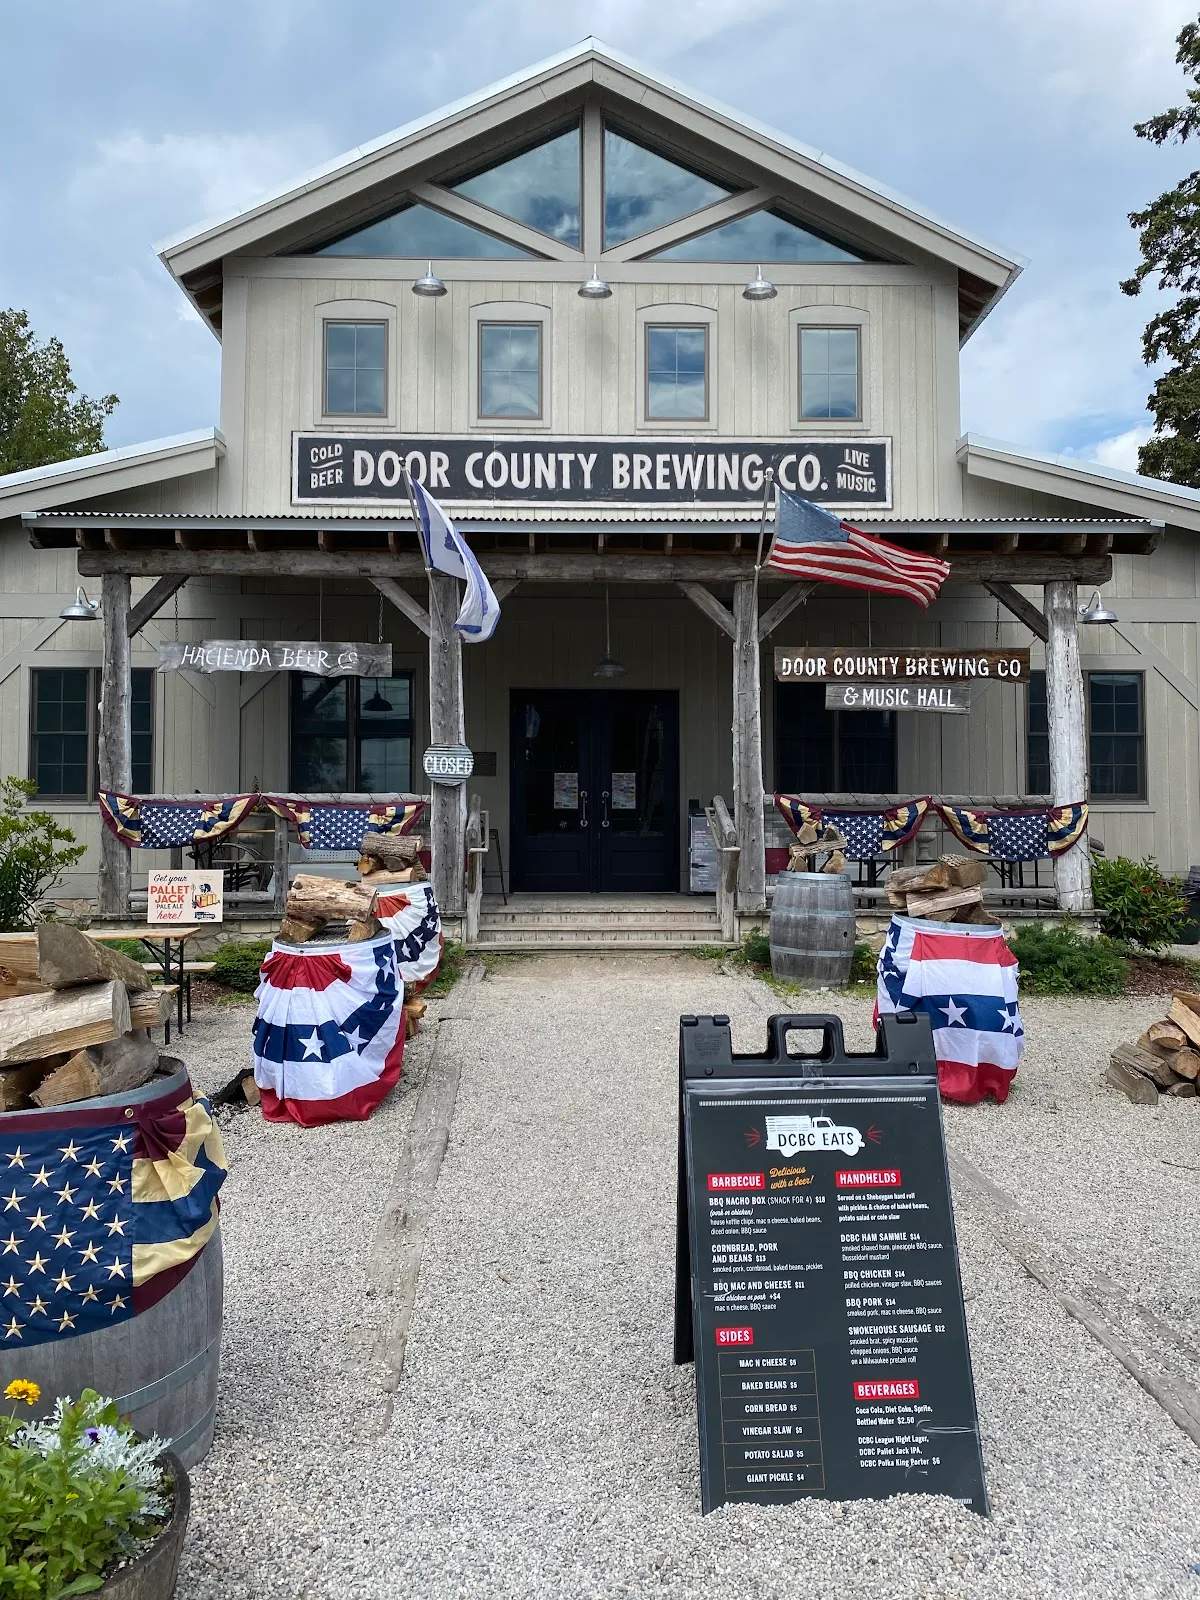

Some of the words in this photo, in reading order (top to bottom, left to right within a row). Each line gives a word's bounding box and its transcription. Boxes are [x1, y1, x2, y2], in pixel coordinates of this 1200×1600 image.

[310, 444, 343, 463] COLD
[844, 449, 869, 467] LIVE
[353, 450, 450, 487] DOOR
[465, 451, 597, 489] COUNTY
[613, 453, 765, 491] BREWING
[778, 454, 828, 491] CO.
[310, 468, 343, 488] BEER
[837, 472, 876, 493] MUSIC
[181, 645, 271, 666] HACIENDA
[279, 648, 331, 668] BEER
[782, 658, 826, 676] DOOR
[834, 657, 899, 675] COUNTY
[905, 658, 989, 677] BREWING
[998, 660, 1021, 676] CO
[844, 687, 859, 705] &
[862, 688, 909, 707] MUSIC
[917, 689, 955, 707] HALL
[425, 756, 473, 774] CLOSED
[168, 875, 188, 885] your
[151, 886, 189, 894] PALLET
[155, 895, 184, 903] JACK
[157, 910, 182, 919] here!
[778, 1134, 815, 1146] DCBC
[823, 1133, 853, 1145] EATS
[770, 1167, 806, 1177] Delicious
[712, 1176, 760, 1187] BARBECUE
[771, 1179, 787, 1189] with
[794, 1175, 814, 1186] beer!
[840, 1173, 896, 1184] HANDHELDS
[709, 1198, 723, 1207] BBQ
[726, 1197, 749, 1205] NACHO
[752, 1197, 766, 1205] BOX
[767, 1197, 790, 1205] (SNACK
[792, 1196, 804, 1204] FOR
[806, 1196, 812, 1204] 4)
[815, 1196, 825, 1204] $18
[867, 1193, 893, 1201] Sheboygan
[840, 1234, 860, 1242] DCBC
[880, 1233, 907, 1241] SAMMIE
[712, 1244, 757, 1253] CORNBREAD,
[759, 1243, 778, 1251] PORK
[892, 1243, 915, 1251] pineapple
[712, 1255, 726, 1263] AND
[729, 1254, 752, 1263] BEANS
[806, 1263, 823, 1271] pickles
[844, 1271, 858, 1280] BBQ
[860, 1270, 892, 1278] CHICKEN
[895, 1270, 905, 1278] $14
[714, 1282, 728, 1292] BBQ
[731, 1281, 746, 1290] MAC
[748, 1281, 762, 1290] AND
[765, 1280, 791, 1289] CHEESE
[795, 1281, 804, 1289] $11
[753, 1293, 766, 1302] pork
[846, 1299, 860, 1308] BBQ
[863, 1298, 882, 1306] PORK
[885, 1298, 896, 1306] $14
[849, 1325, 897, 1335] SMOKEHOUSE
[900, 1324, 932, 1333] SAUSAGE
[720, 1330, 749, 1343] SIDES
[850, 1348, 871, 1356] chopped
[892, 1346, 902, 1354] BBQ
[740, 1359, 753, 1367] MAC
[756, 1359, 760, 1367] N
[762, 1358, 787, 1367] CHEESE
[890, 1356, 907, 1364] pretzel
[742, 1382, 763, 1390] BAKED
[765, 1381, 787, 1389] BEANS
[858, 1384, 915, 1396] BEVERAGES
[745, 1405, 763, 1413] CORN
[766, 1404, 787, 1412] BREAD
[790, 1404, 797, 1412] $5
[897, 1417, 914, 1425] $2.50
[742, 1427, 771, 1435] VINEGAR
[774, 1426, 791, 1435] SLAW
[858, 1436, 873, 1444] DCBC
[875, 1436, 894, 1445] League
[895, 1436, 911, 1444] Night
[744, 1451, 770, 1460] POTATO
[772, 1450, 793, 1458] SALAD
[895, 1459, 910, 1467] King
[911, 1458, 929, 1466] Porter
[932, 1457, 940, 1465] $6
[747, 1474, 767, 1483] GIANT
[769, 1473, 793, 1482] PICKLE
